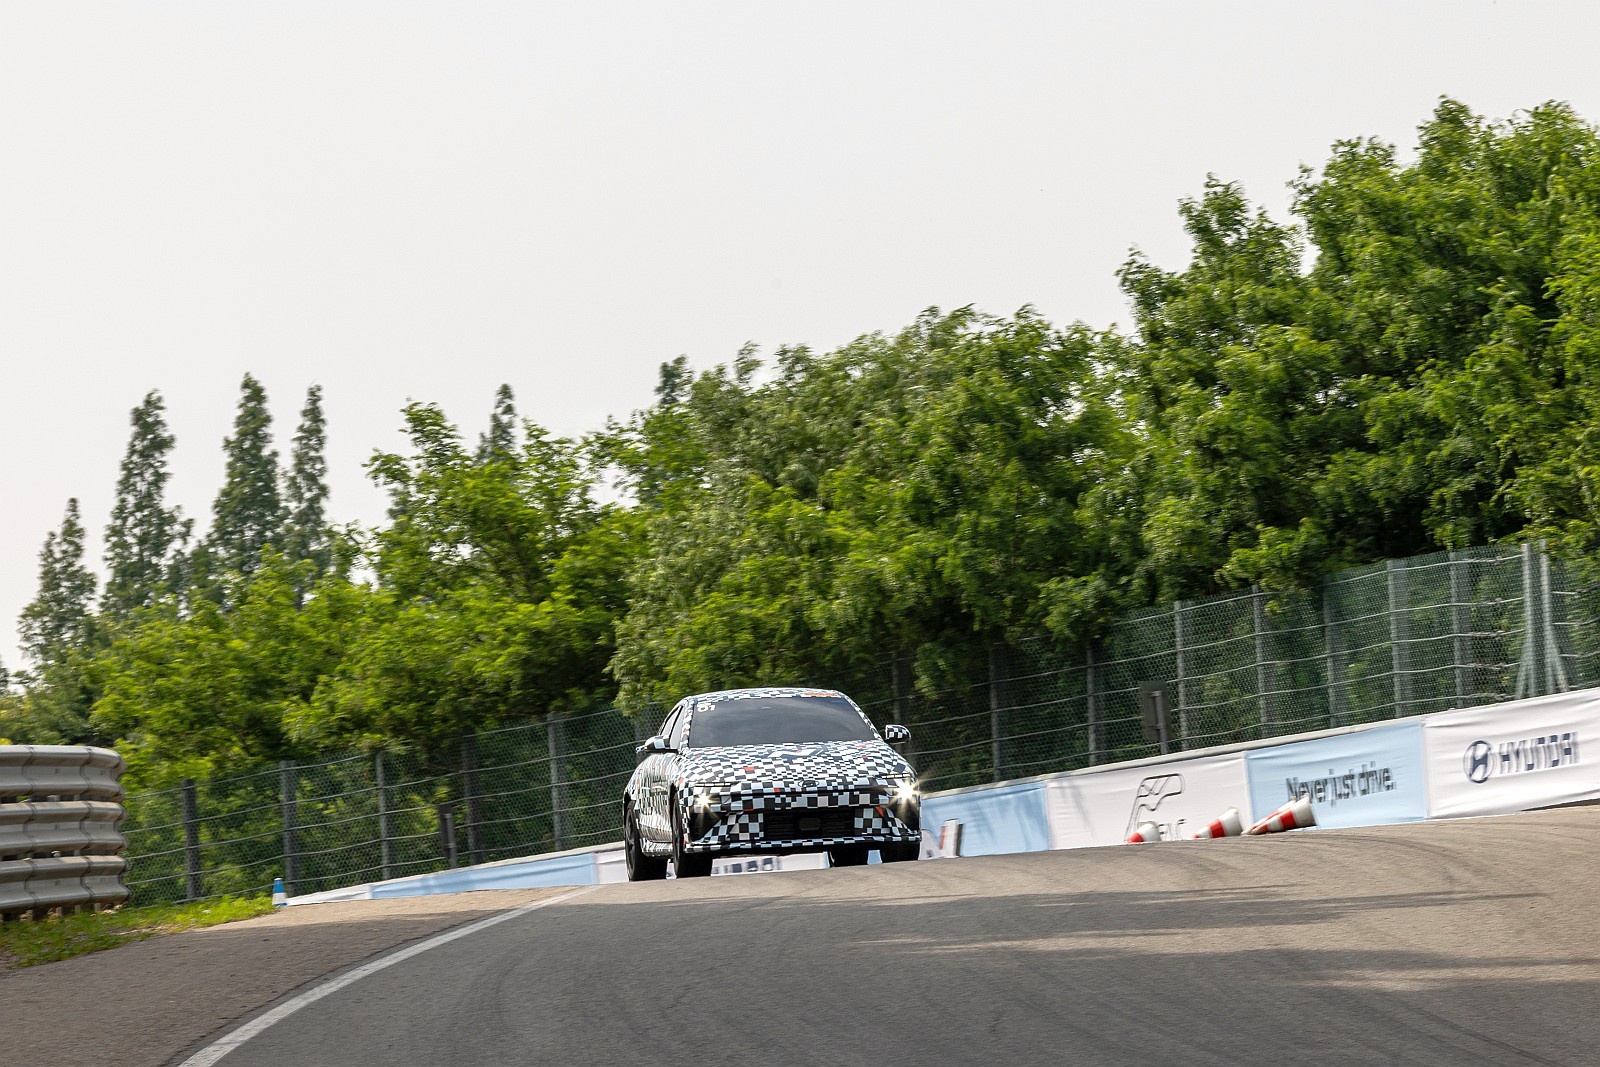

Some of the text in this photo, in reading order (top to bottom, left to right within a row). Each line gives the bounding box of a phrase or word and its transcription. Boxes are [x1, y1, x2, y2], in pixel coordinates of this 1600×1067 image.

[1499, 732, 1579, 775] HYUNDAI
[1286, 777, 1328, 804] Never
[1327, 768, 1356, 807] just
